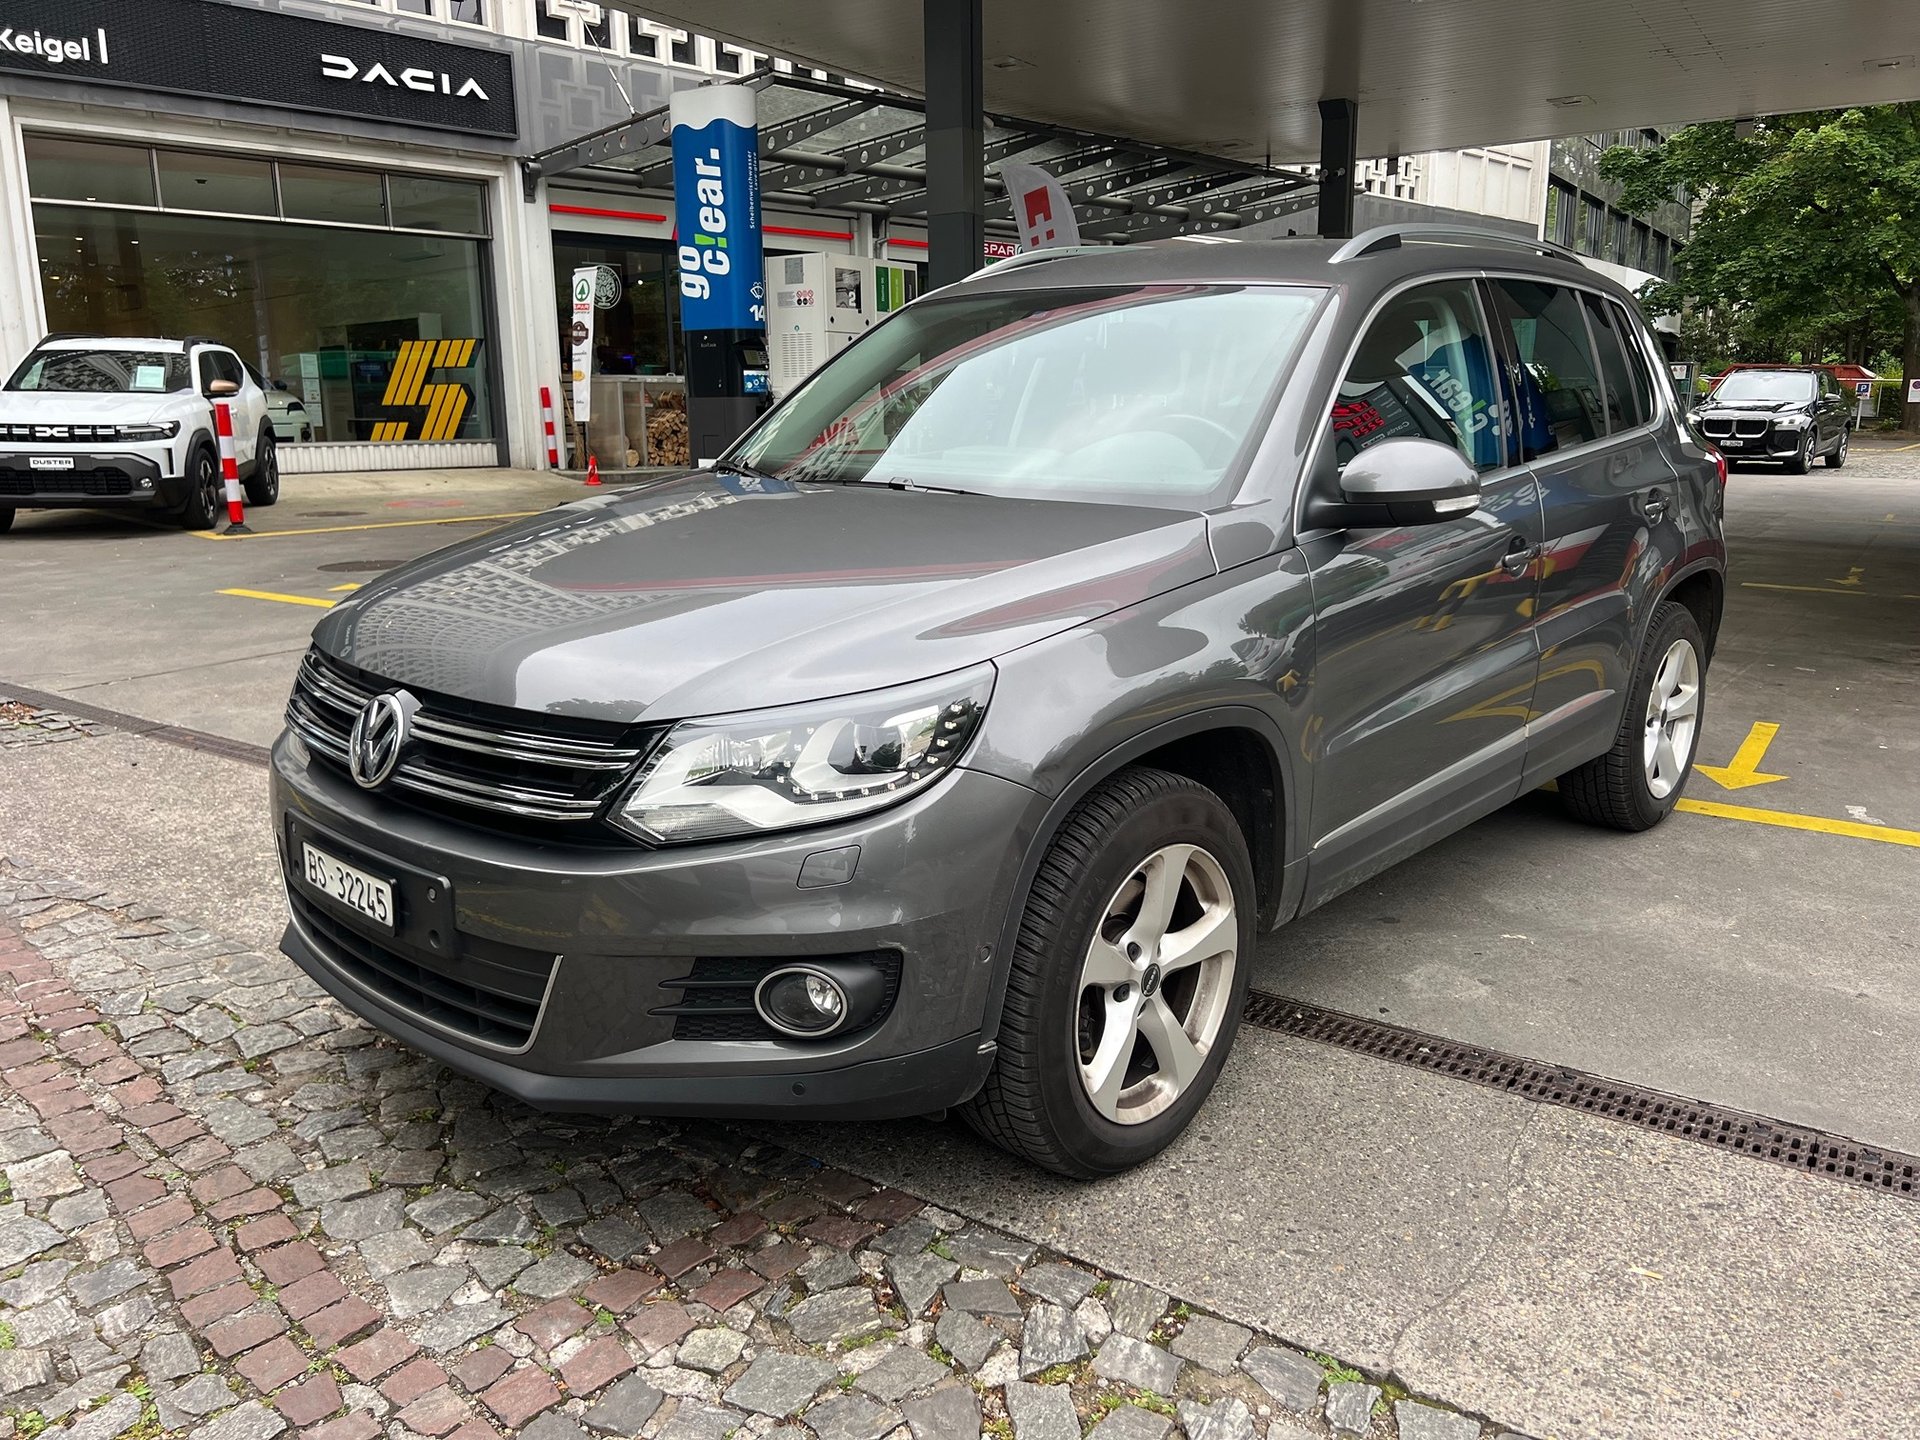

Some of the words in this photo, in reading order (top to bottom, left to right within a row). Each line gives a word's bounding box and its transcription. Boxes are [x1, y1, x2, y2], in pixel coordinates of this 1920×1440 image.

[0, 28, 91, 63] Keigel
[321, 53, 490, 101] DACIA
[984, 243, 1016, 256] SPAR
[678, 245, 711, 300] go
[848, 291, 857, 307] 2
